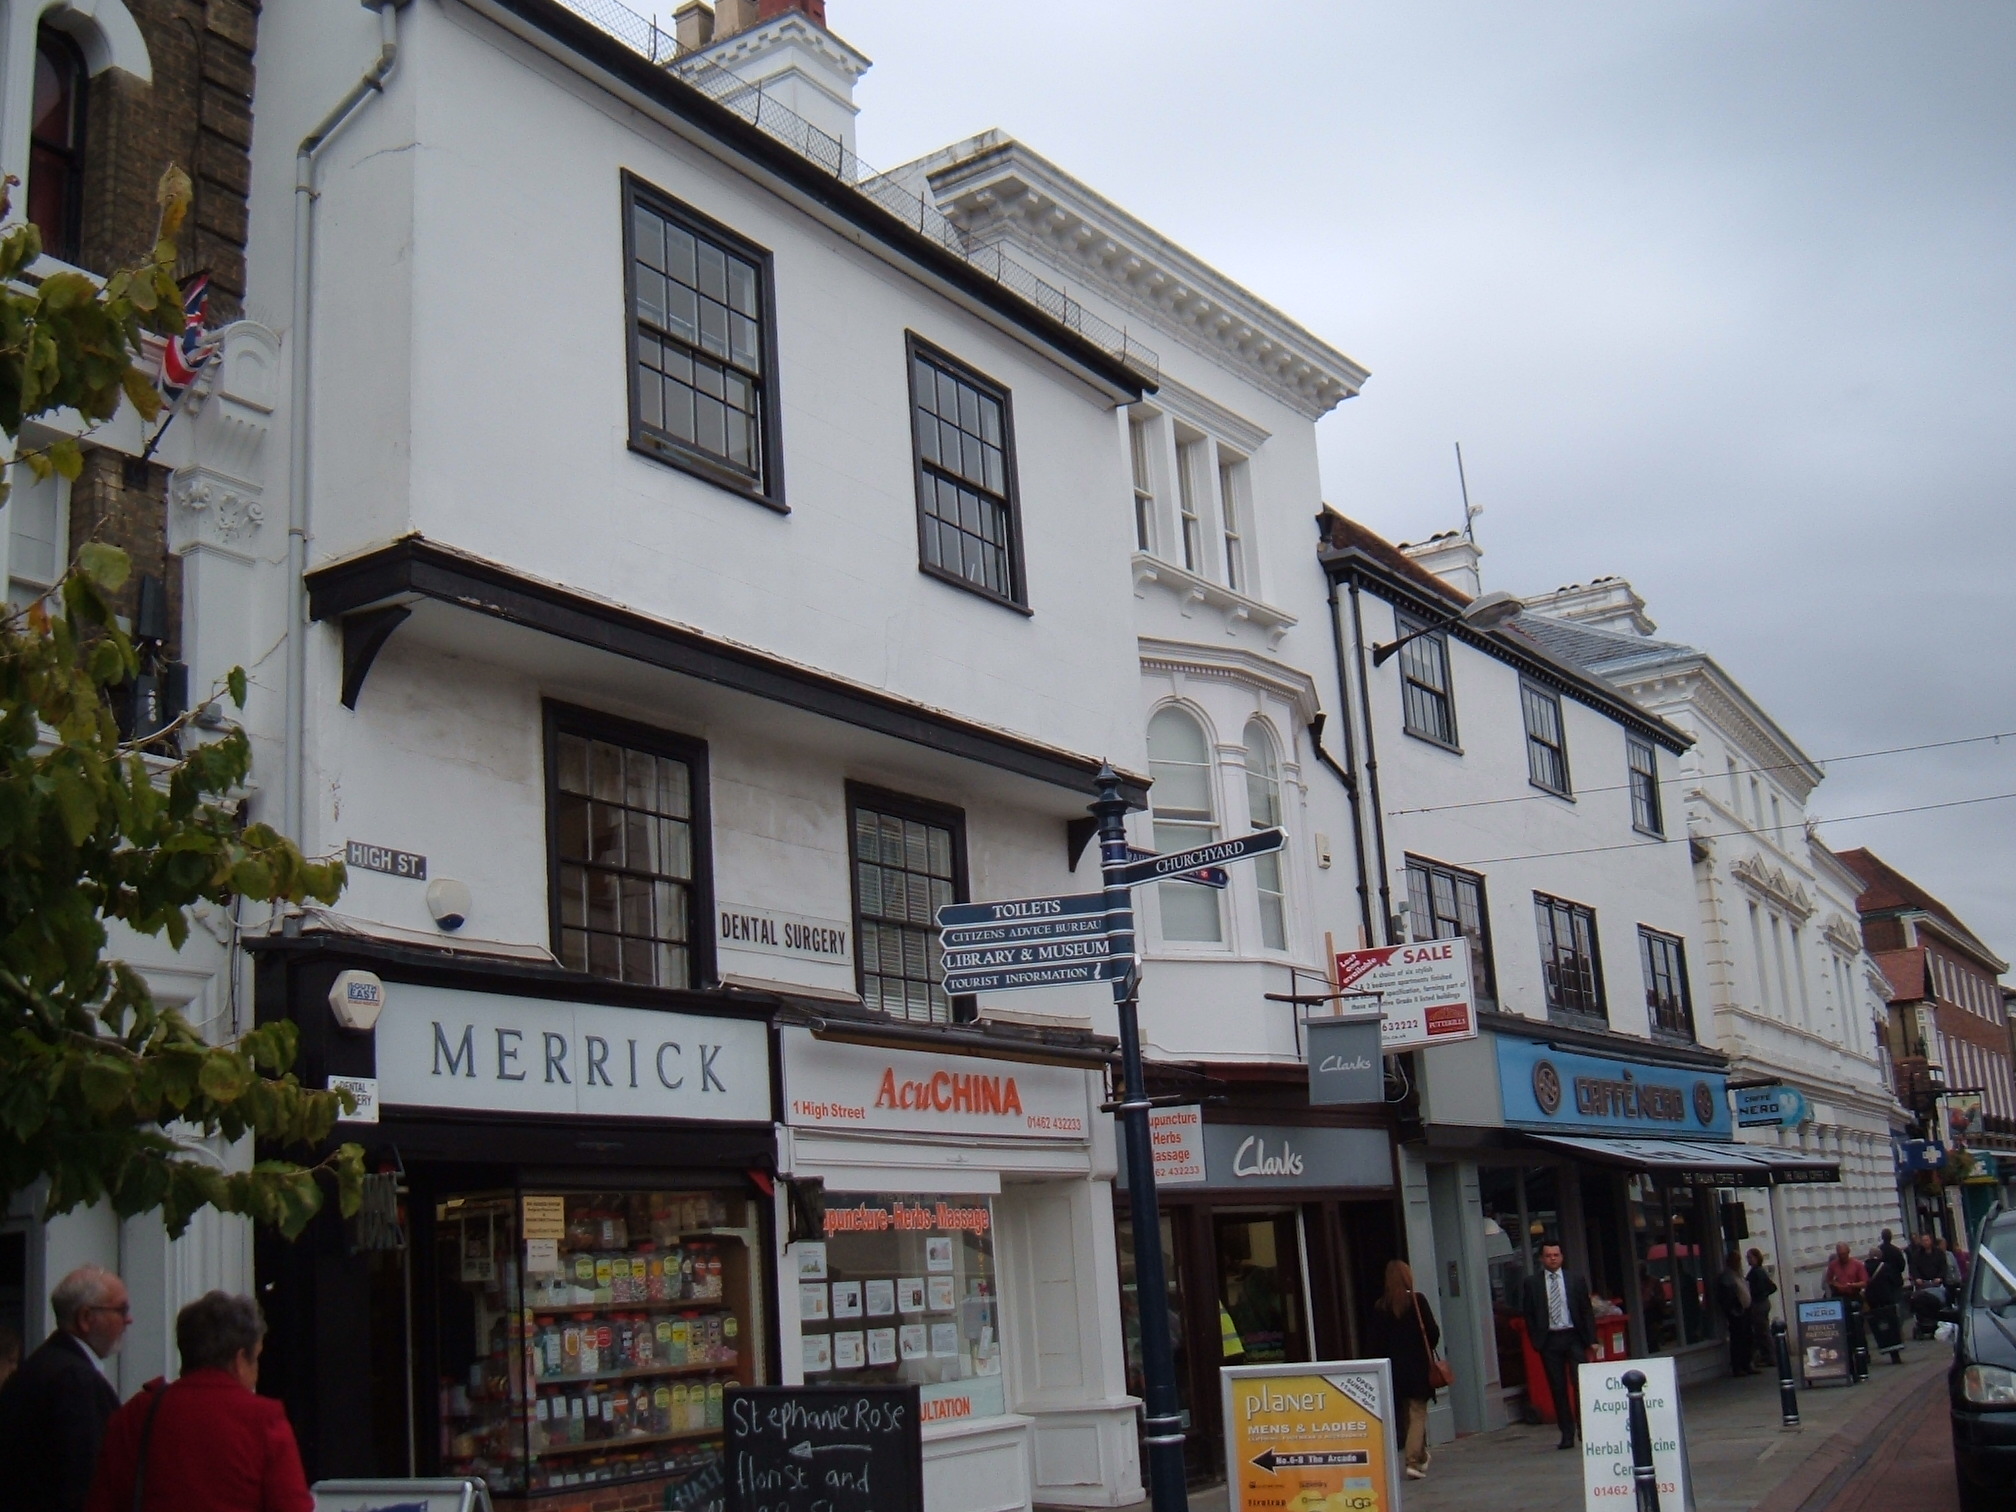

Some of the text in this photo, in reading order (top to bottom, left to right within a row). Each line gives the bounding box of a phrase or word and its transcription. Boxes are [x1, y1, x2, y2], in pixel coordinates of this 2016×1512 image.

[351, 844, 392, 870] HIGH
[1156, 841, 1245, 873] CHURCHYARD
[992, 900, 1061, 918] TOILETS
[721, 912, 846, 955] DENTAL SURGERY
[952, 920, 1102, 942] CITIZENS ADVICE BUREAU
[946, 940, 1110, 968] LIBRARY & MUSEUM
[1403, 945, 1453, 964] SALE
[950, 976, 999, 989] TOURIST
[1005, 967, 1088, 984] INFORMATION
[351, 988, 377, 999] EAST
[432, 1021, 726, 1093] MERRICK
[1319, 1055, 1371, 1072] Clarks
[875, 1066, 1023, 1116] AcuCHINA
[793, 1101, 866, 1120] 1 High Street
[1636, 1084, 1685, 1121] NERO
[1740, 1104, 1779, 1115] NERO
[1027, 1115, 1081, 1131] 01462 432233
[1153, 1131, 1182, 1145] Herbs
[1152, 1149, 1190, 1163] assage
[1233, 1135, 1304, 1177] Clarks
[1346, 1378, 1376, 1401] SUNDAYS
[1356, 1376, 1374, 1391] OPEN
[920, 1396, 971, 1421] ULTATION
[733, 1398, 905, 1440] Stephanie Rose
[1247, 1421, 1367, 1435] MENS & LADIES
[1308, 1455, 1323, 1463] The
[1328, 1454, 1357, 1463] Arcade
[1586, 1441, 1623, 1456] Herbal
[825, 1461, 870, 1494] and
[1594, 1485, 1628, 1497] 01462
